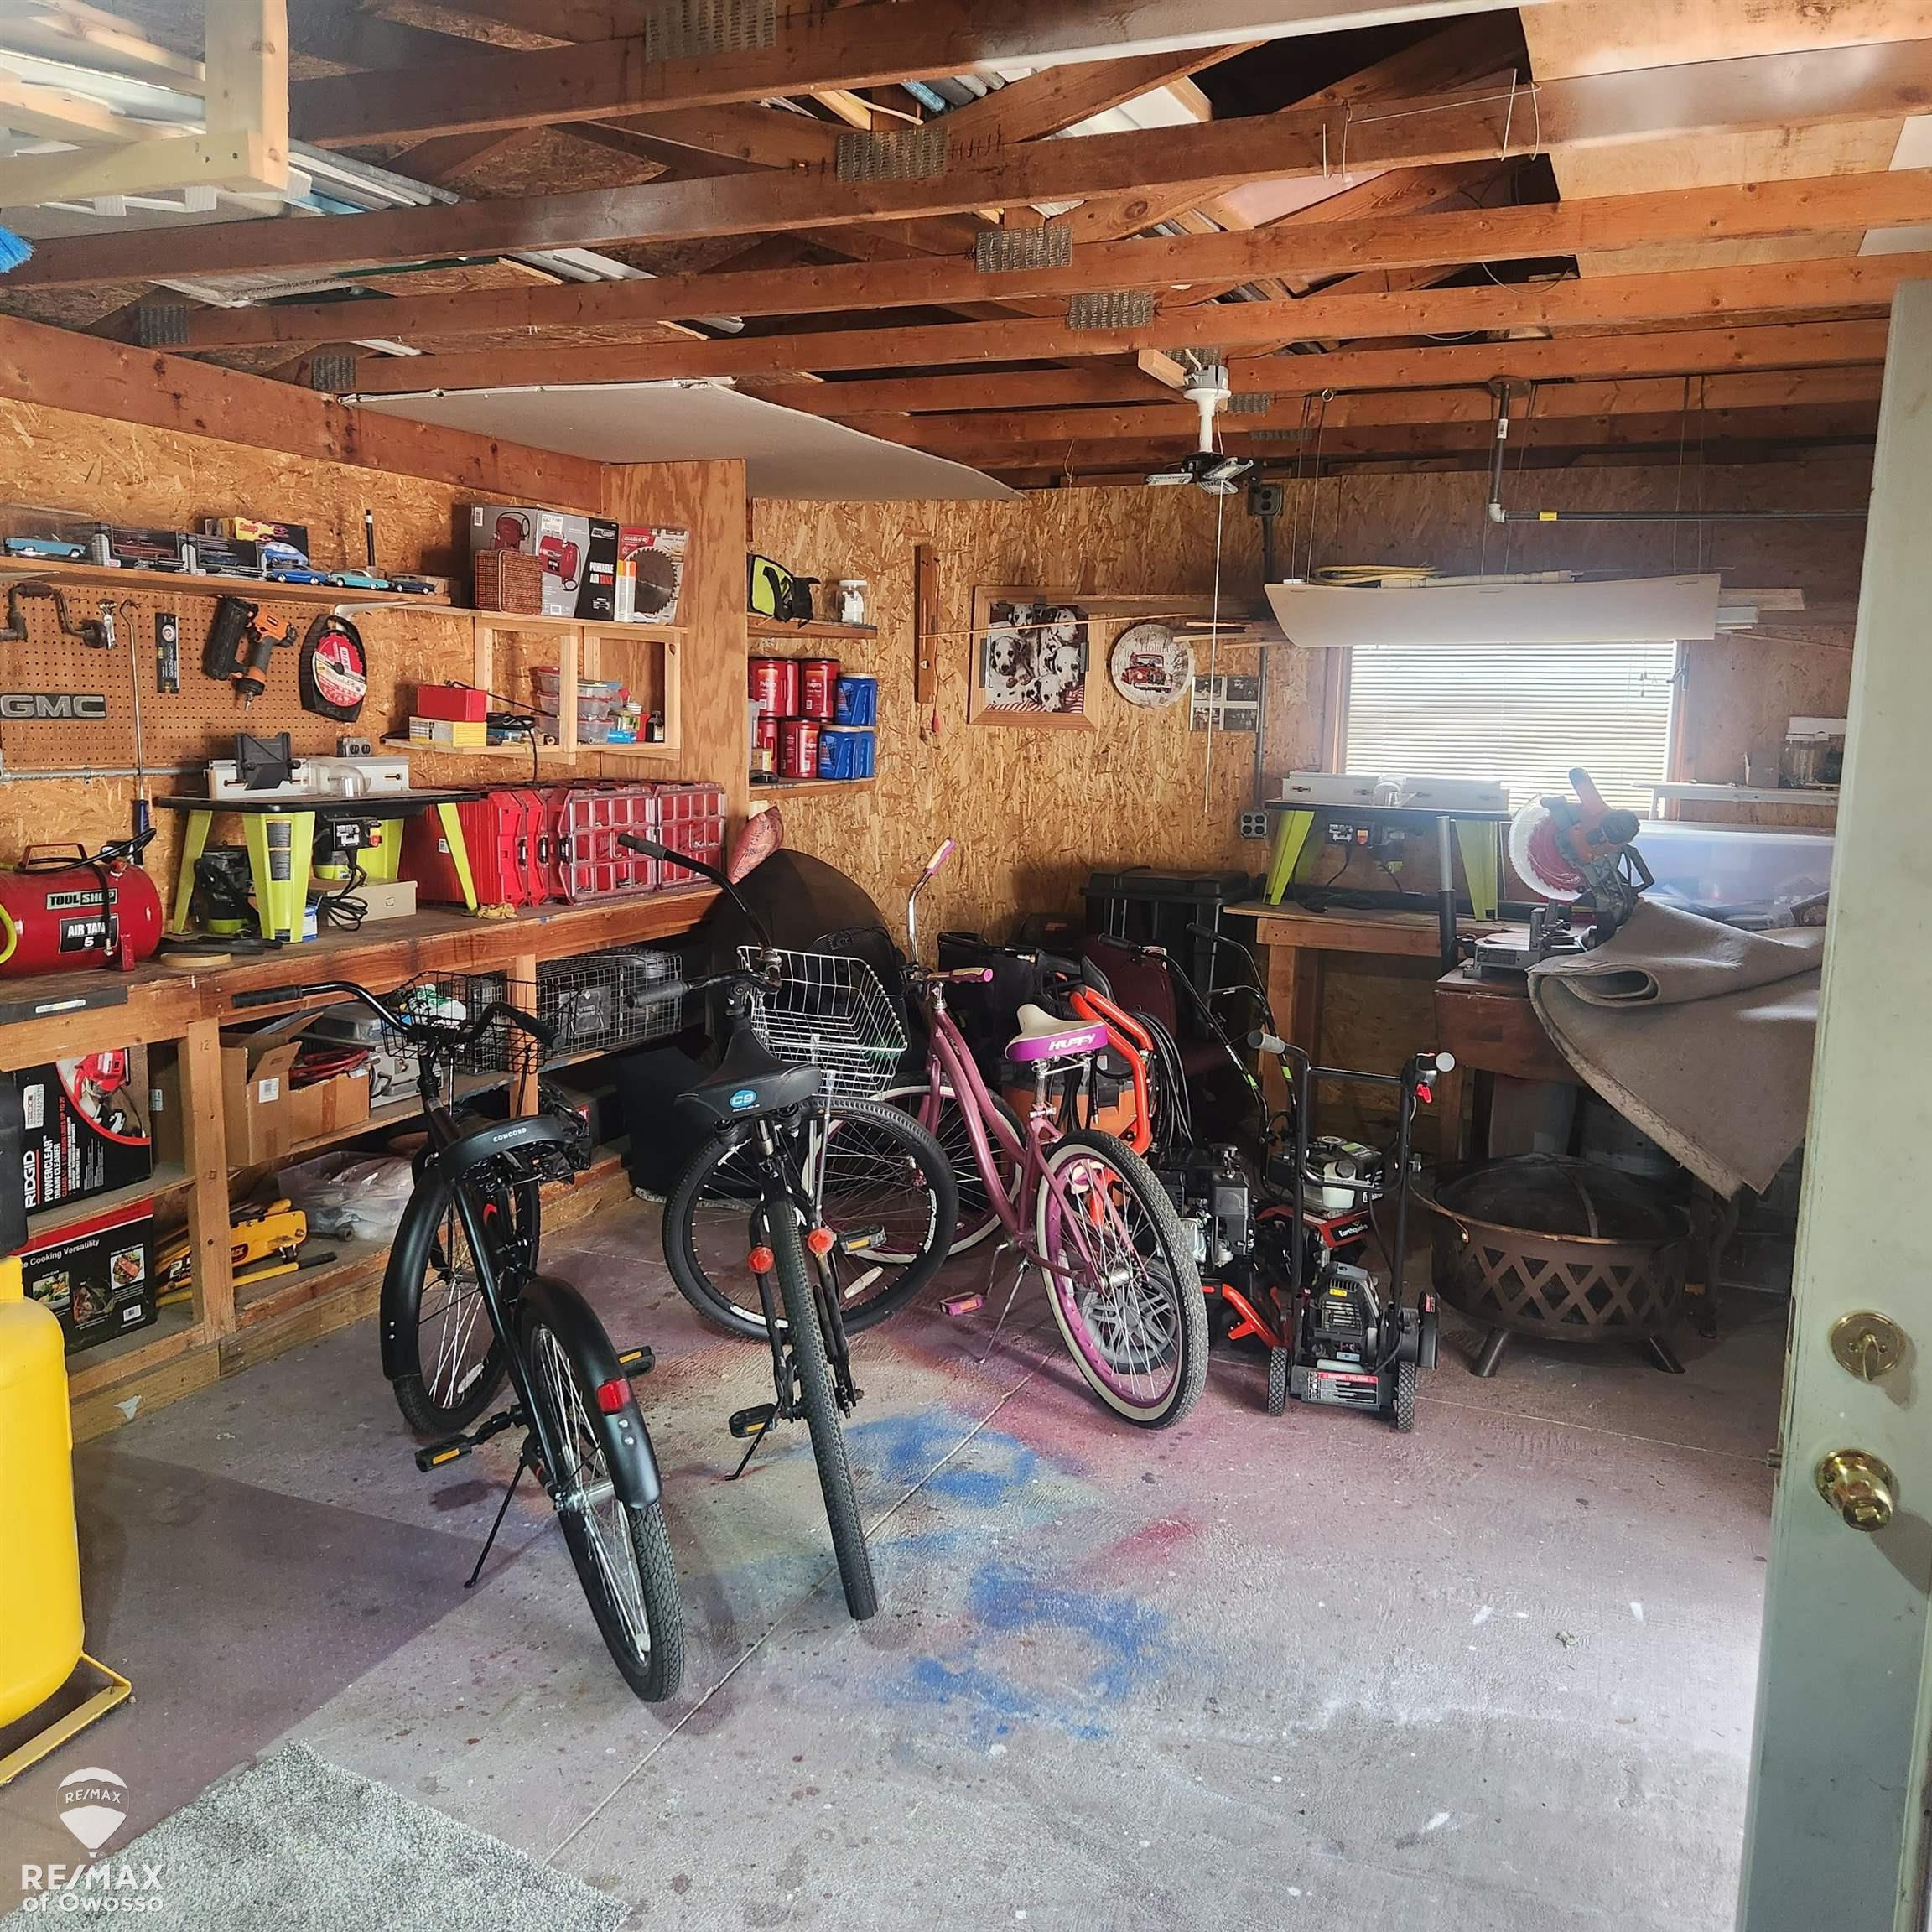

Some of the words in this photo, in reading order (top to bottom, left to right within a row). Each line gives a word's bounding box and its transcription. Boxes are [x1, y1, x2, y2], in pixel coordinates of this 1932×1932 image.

[0, 694, 106, 717] GMC
[49, 894, 80, 906] TOOL
[67, 923, 85, 938] AIR
[86, 922, 106, 936] TAN
[84, 936, 95, 947] 5
[1048, 1032, 1096, 1051] HUFFY
[493, 1127, 527, 1142] CONCORD
[53, 1143, 61, 1175] CLEANER
[23, 1150, 36, 1209] RIDGID
[29, 1251, 62, 1266] Cooking
[63, 1239, 100, 1255] Versatility
